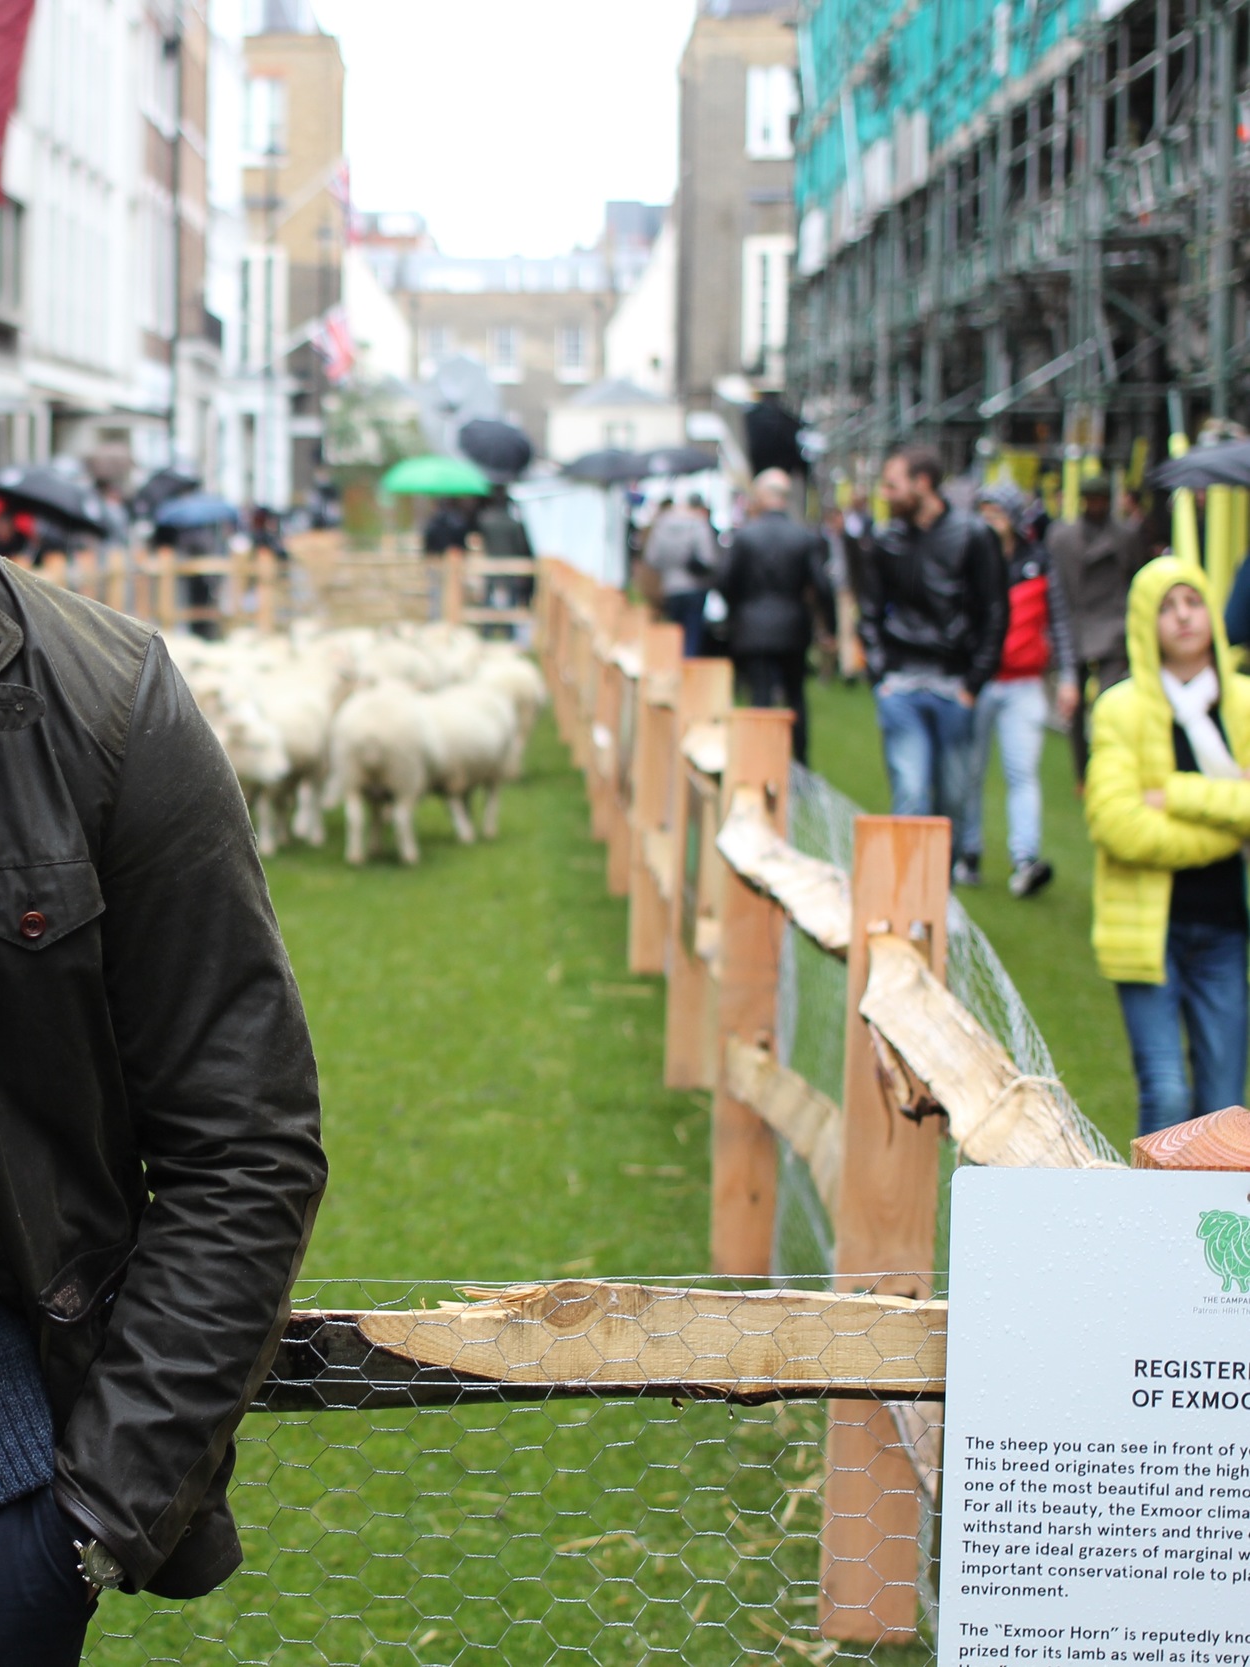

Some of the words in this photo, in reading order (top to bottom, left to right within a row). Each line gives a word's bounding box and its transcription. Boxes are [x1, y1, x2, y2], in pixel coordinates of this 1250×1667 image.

[1203, 1296, 1219, 1304] THE
[1134, 1359, 1250, 1381] REGISTER
[1131, 1388, 1165, 1408] OF
[965, 1436, 995, 1450] The
[999, 1437, 1049, 1455] sheep
[1052, 1441, 1082, 1456] you
[1086, 1442, 1116, 1453] can
[1120, 1443, 1149, 1454] see
[1153, 1440, 1167, 1455] in
[1172, 1441, 1214, 1456] front
[1218, 1442, 1236, 1457] of
[964, 1457, 997, 1471] This
[1001, 1457, 1050, 1473] breed
[1054, 1459, 1135, 1477] originates
[1139, 1461, 1179, 1476] from
[1183, 1462, 1211, 1477] the
[1216, 1463, 1250, 1481] high
[964, 1481, 995, 1492] one
[998, 1478, 1017, 1492] of
[1020, 1479, 1048, 1493] the
[1052, 1481, 1093, 1495] most
[1097, 1481, 1170, 1497] beautiful
[1174, 1483, 1204, 1498] and
[964, 1498, 991, 1513] For
[994, 1499, 1013, 1513] all
[1017, 1499, 1037, 1514] its
[1042, 1500, 1103, 1519] beauty,
[1108, 1502, 1136, 1517] the
[1140, 1503, 1203, 1518] Exmoor
[1207, 1505, 1250, 1520] clima
[962, 1519, 1043, 1535] withstand
[1047, 1521, 1092, 1536] harsh
[1097, 1522, 1157, 1538] winters
[1161, 1525, 1191, 1539] and
[1195, 1525, 1244, 1540] thrive
[961, 1540, 1001, 1558] They
[1004, 1544, 1031, 1555] are
[1035, 1541, 1074, 1557] ideal
[1078, 1546, 1138, 1560] grazers
[1142, 1545, 1160, 1559] of
[1164, 1546, 1233, 1564] marginal
[961, 1560, 1043, 1578] important
[1047, 1564, 1168, 1580] conservational
[1173, 1566, 1206, 1581] role
[1209, 1567, 1228, 1582] to
[960, 1581, 1069, 1598] environment.
[958, 1622, 989, 1637] The
[1124, 1626, 1137, 1641] is
[1141, 1629, 1221, 1647] reputedly
[959, 1643, 1010, 1660] prized
[1014, 1644, 1039, 1659] for
[1042, 1645, 1062, 1660] its
[1067, 1646, 1106, 1661] lamb
[1110, 1650, 1128, 1662] as
[1132, 1648, 1165, 1663] well
[1168, 1652, 1186, 1663] as
[1190, 1649, 1210, 1664] its
[1214, 1653, 1250, 1667] very
